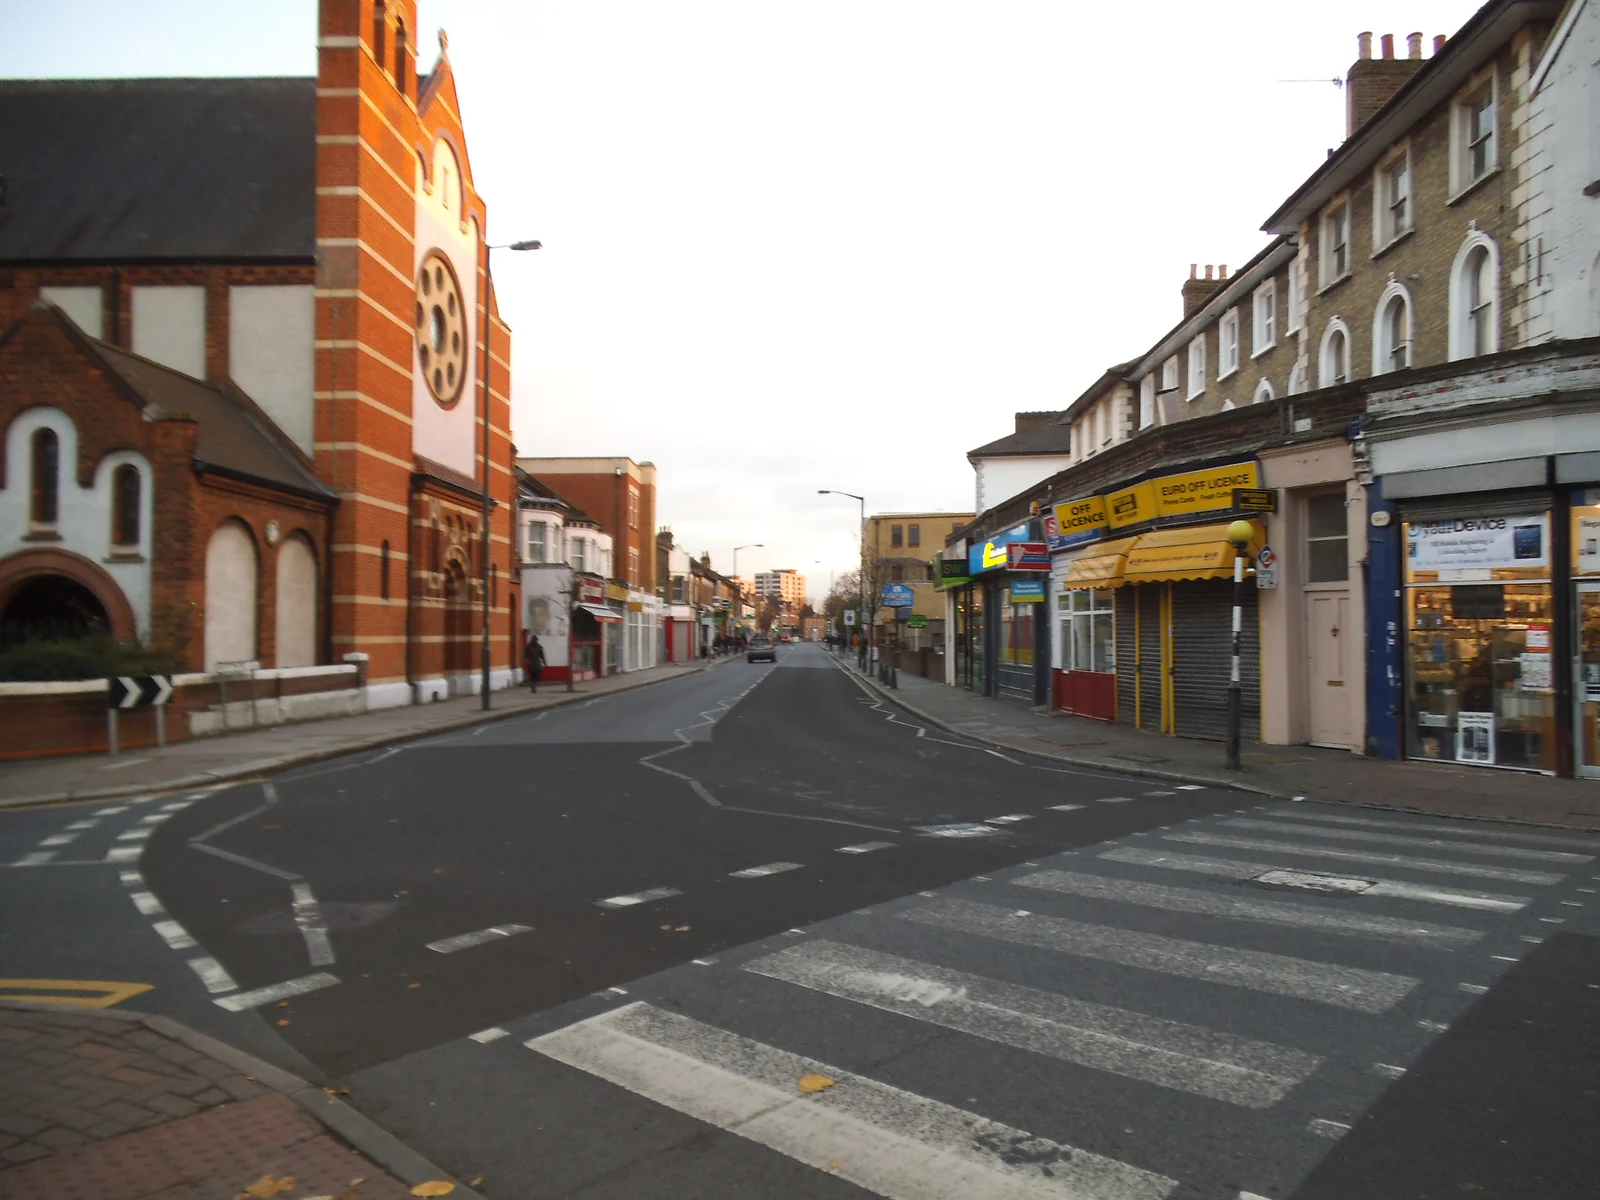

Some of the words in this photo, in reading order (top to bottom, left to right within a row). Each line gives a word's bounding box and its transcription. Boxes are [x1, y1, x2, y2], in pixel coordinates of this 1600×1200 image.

[1161, 484, 1187, 496] EURO
[1188, 480, 1206, 492] OFF
[1208, 473, 1250, 489] LICENCE
[1071, 503, 1091, 516] OFF
[1061, 511, 1105, 529] LICENCE
[1453, 518, 1507, 532] Device
